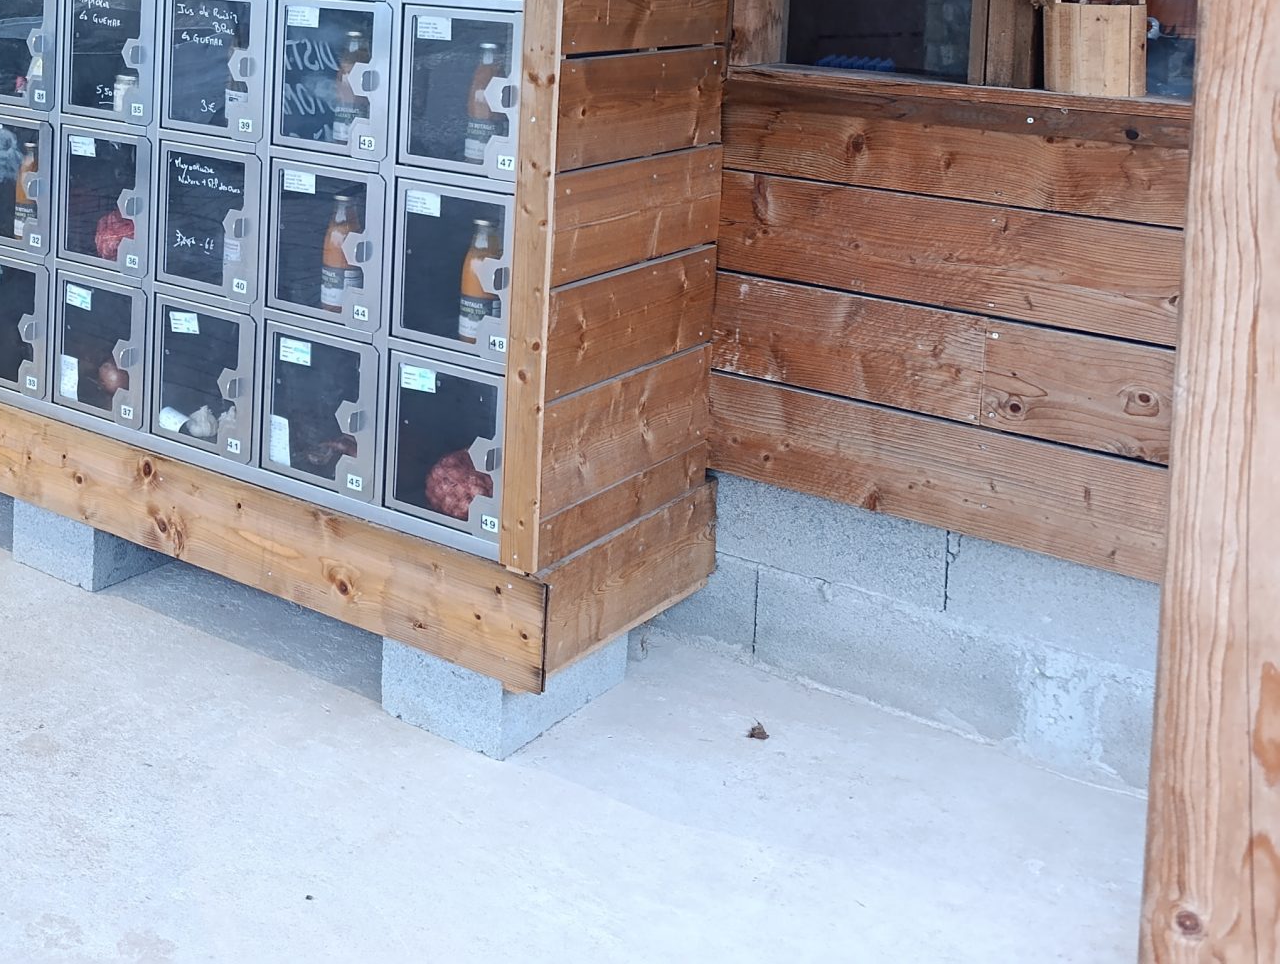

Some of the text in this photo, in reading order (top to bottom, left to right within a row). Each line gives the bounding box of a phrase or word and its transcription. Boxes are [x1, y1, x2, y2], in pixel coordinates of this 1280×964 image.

[177, 3, 195, 16] Jus
[199, 5, 209, 18] de
[132, 105, 142, 114] 35
[200, 99, 217, 113] 3€
[240, 121, 250, 131] 39
[361, 138, 373, 148] 43
[500, 158, 512, 168] 47
[31, 236, 40, 245] 32
[128, 257, 137, 266] 36
[235, 281, 245, 291] 40
[354, 308, 366, 318] 44
[490, 339, 504, 350] 48
[27, 378, 36, 388] 33
[122, 407, 131, 417] 37
[227, 440, 238, 451] 41
[348, 477, 360, 488] 45
[482, 518, 497, 529] 49
